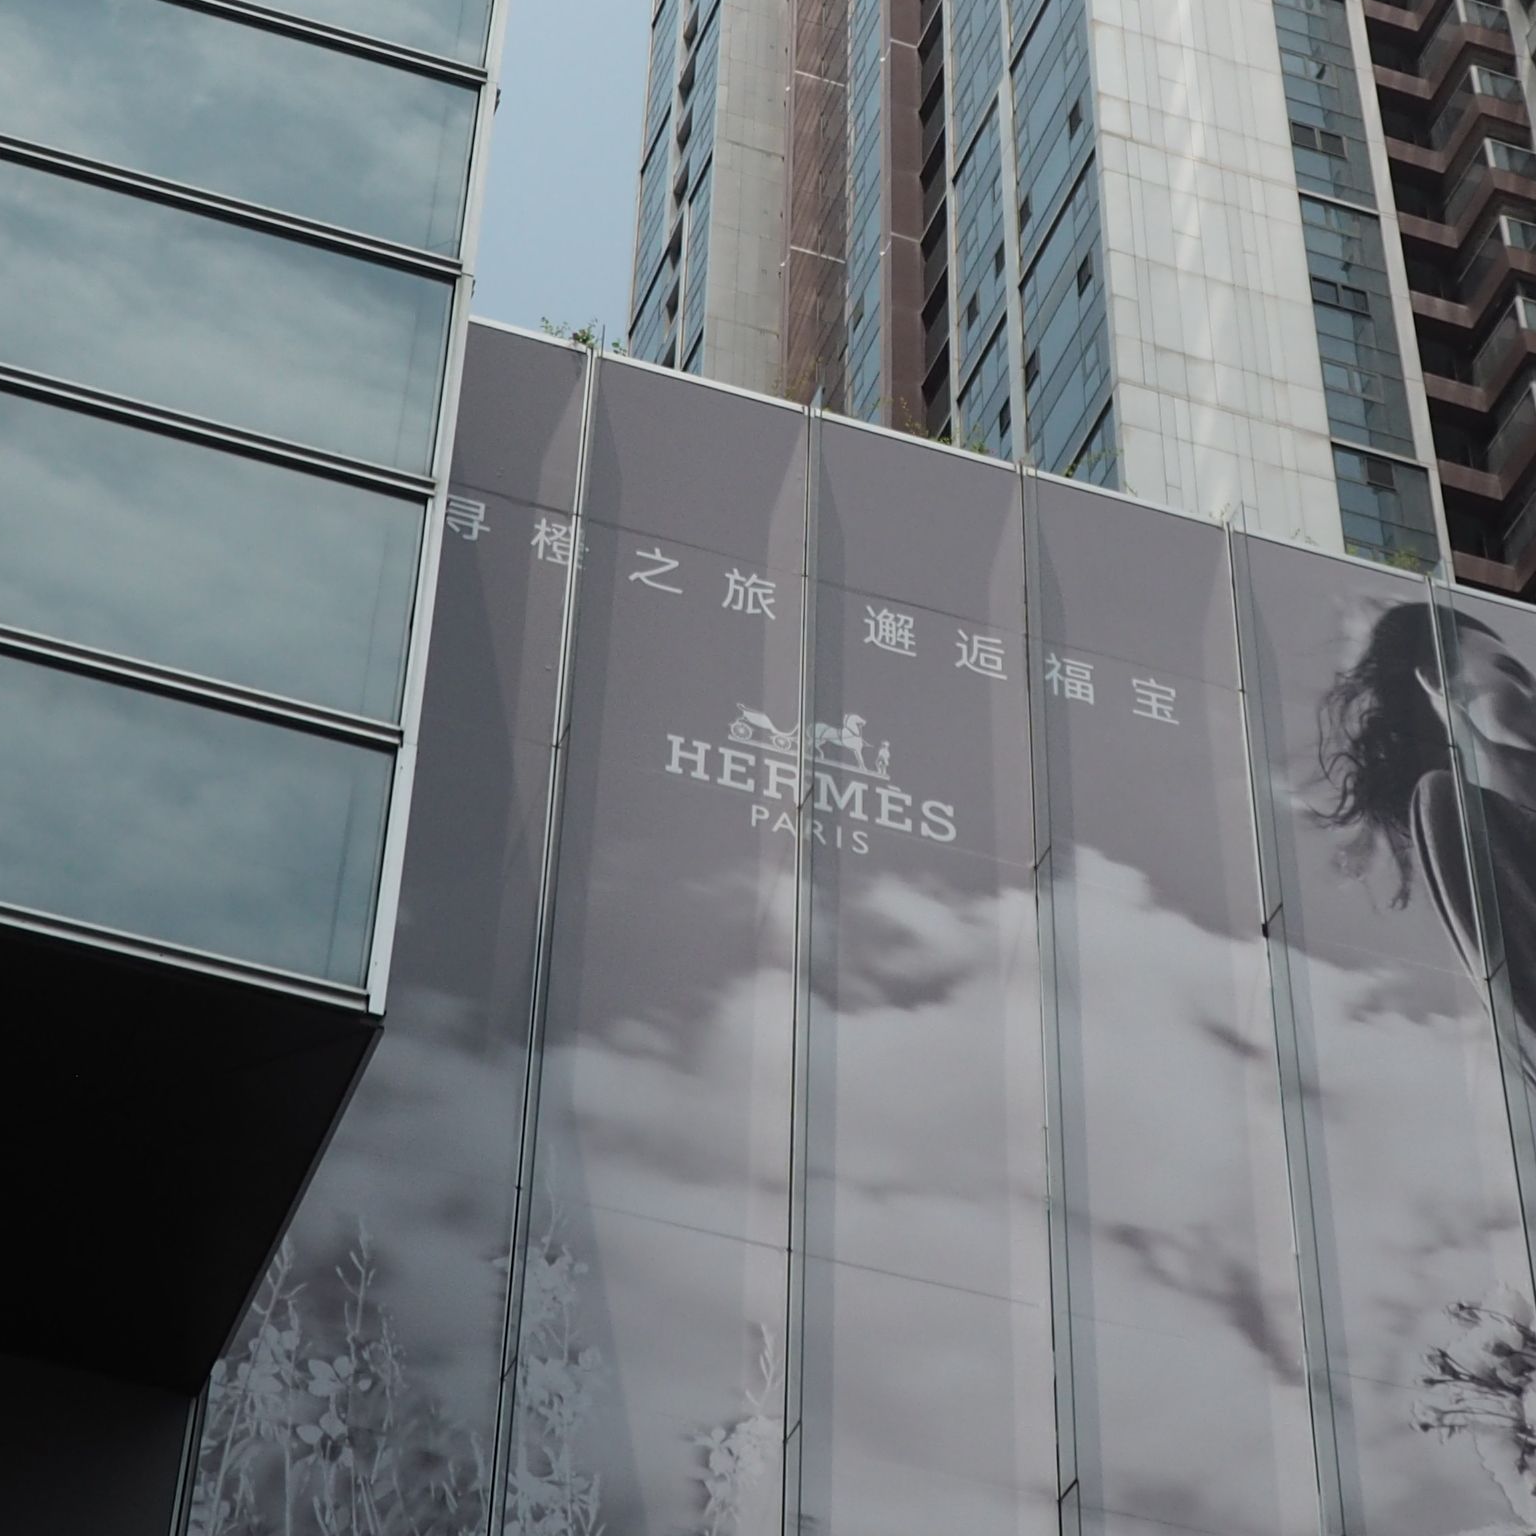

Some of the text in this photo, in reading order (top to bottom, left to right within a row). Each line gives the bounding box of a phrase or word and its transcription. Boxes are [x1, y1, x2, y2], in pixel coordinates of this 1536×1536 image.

[864, 605, 1179, 725] 邂逅福宝
[666, 733, 957, 842] HERMÈS
[751, 804, 870, 855] PARIS
